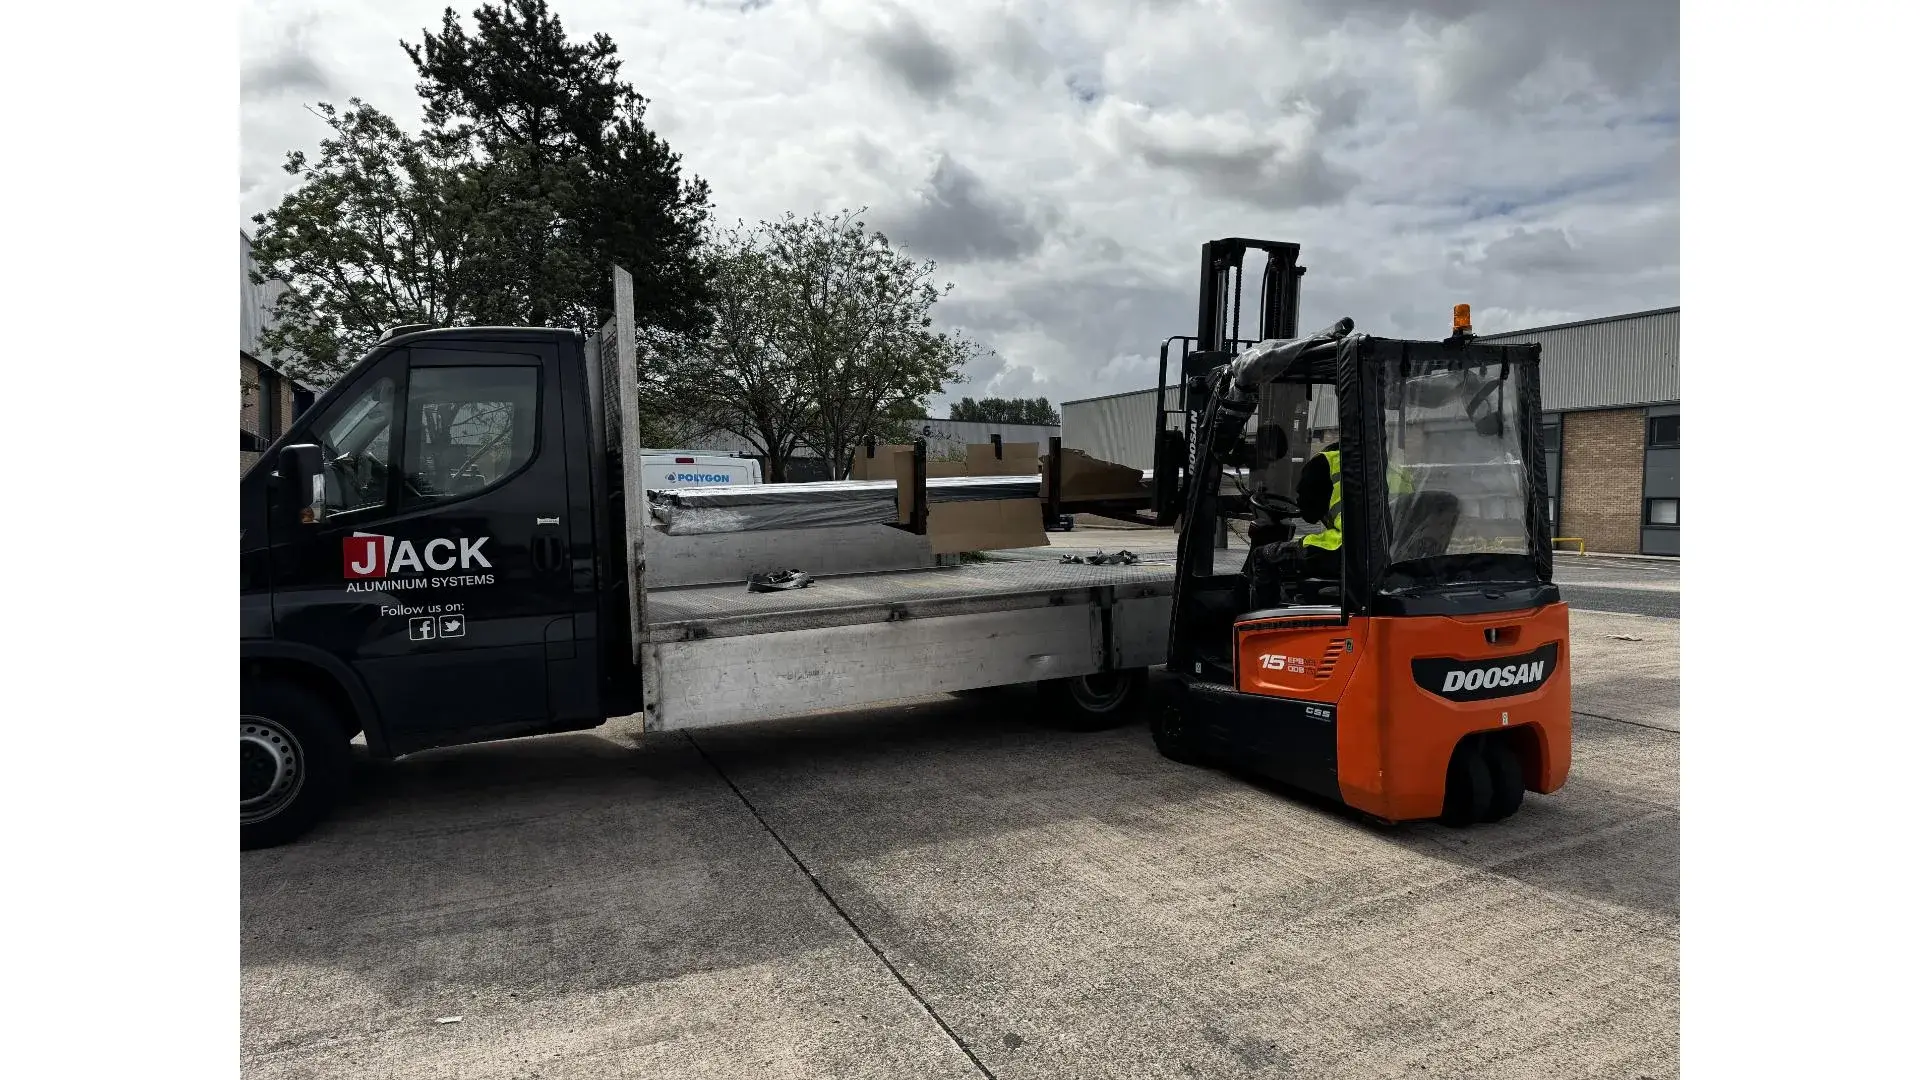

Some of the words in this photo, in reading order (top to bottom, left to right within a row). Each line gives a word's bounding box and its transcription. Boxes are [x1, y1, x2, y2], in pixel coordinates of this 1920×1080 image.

[1188, 409, 1198, 476] DOOSAN
[677, 473, 730, 483] POLYGON
[351, 536, 493, 575] JACK
[346, 578, 428, 593] ALUMINIUM
[431, 574, 495, 588] SYSTEMS
[381, 604, 424, 617] Follow
[428, 604, 442, 613] us
[445, 602, 465, 612] on:
[1259, 653, 1287, 670] 15
[1442, 660, 1545, 692] DOOSAN
